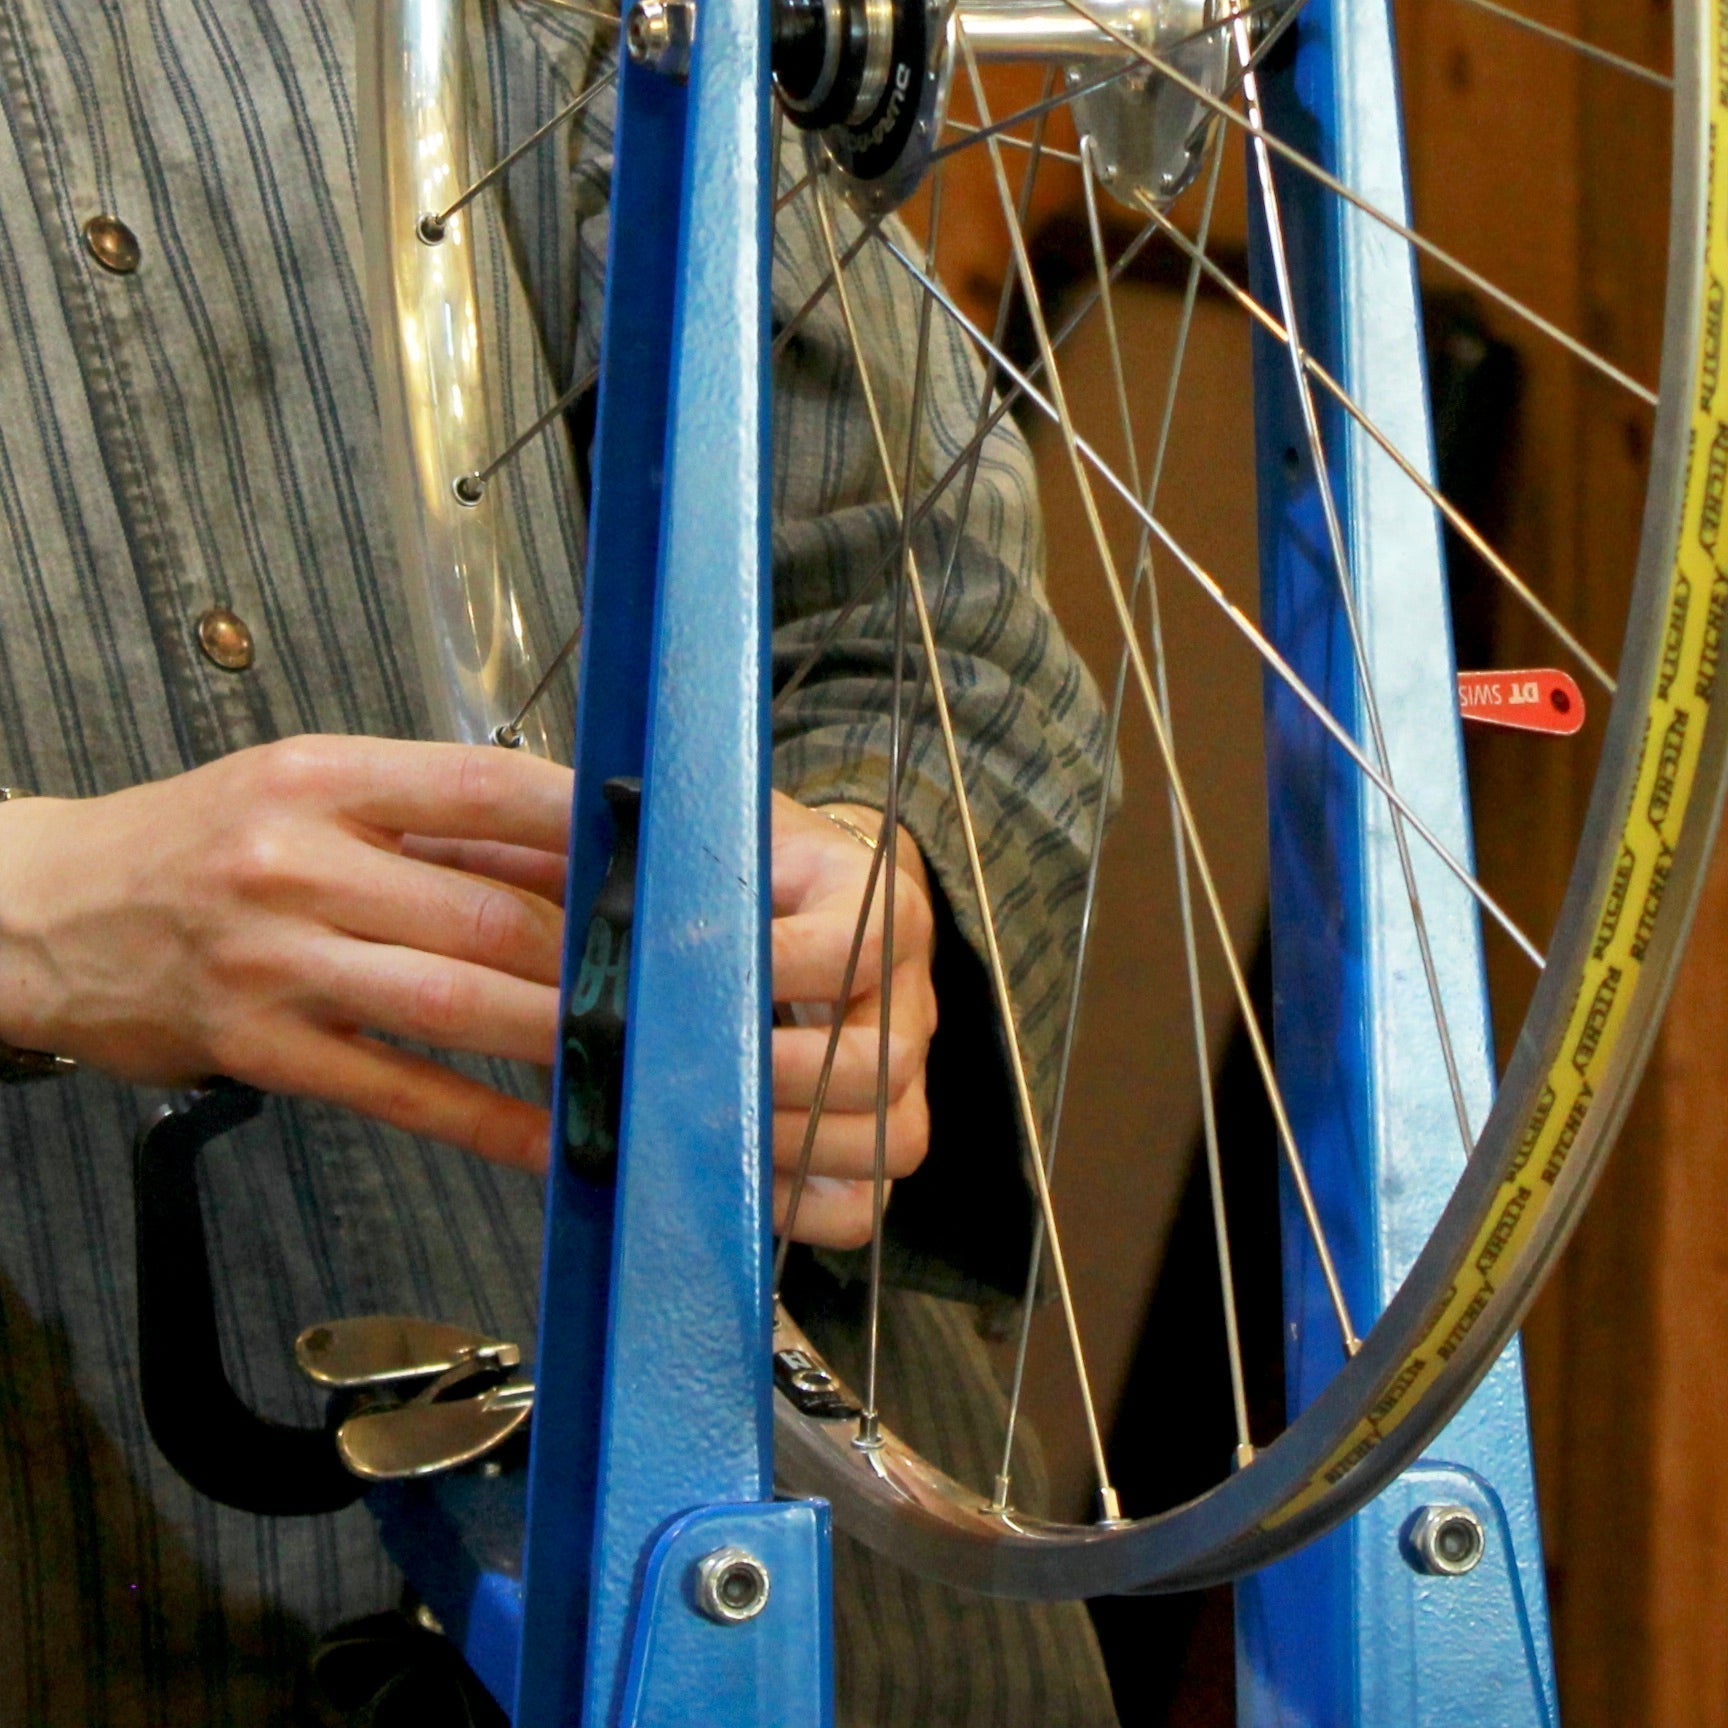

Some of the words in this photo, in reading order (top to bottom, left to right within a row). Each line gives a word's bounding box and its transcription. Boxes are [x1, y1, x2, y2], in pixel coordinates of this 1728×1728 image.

[1700, 274, 1724, 419] RITCHEY
[1695, 566, 1728, 703] RITCHEY
[1459, 684, 1502, 706] SWIS
[1508, 682, 1539, 704] DT
[1648, 709, 1689, 833] RITCHEY
[1630, 839, 1675, 961] RITCHEY
[1573, 966, 1621, 1077] RITCHEY
[1542, 1078, 1594, 1186] RITCHEY
[1476, 1186, 1532, 1276] RITCHEY
[1438, 1279, 1495, 1361] RITCHEY
